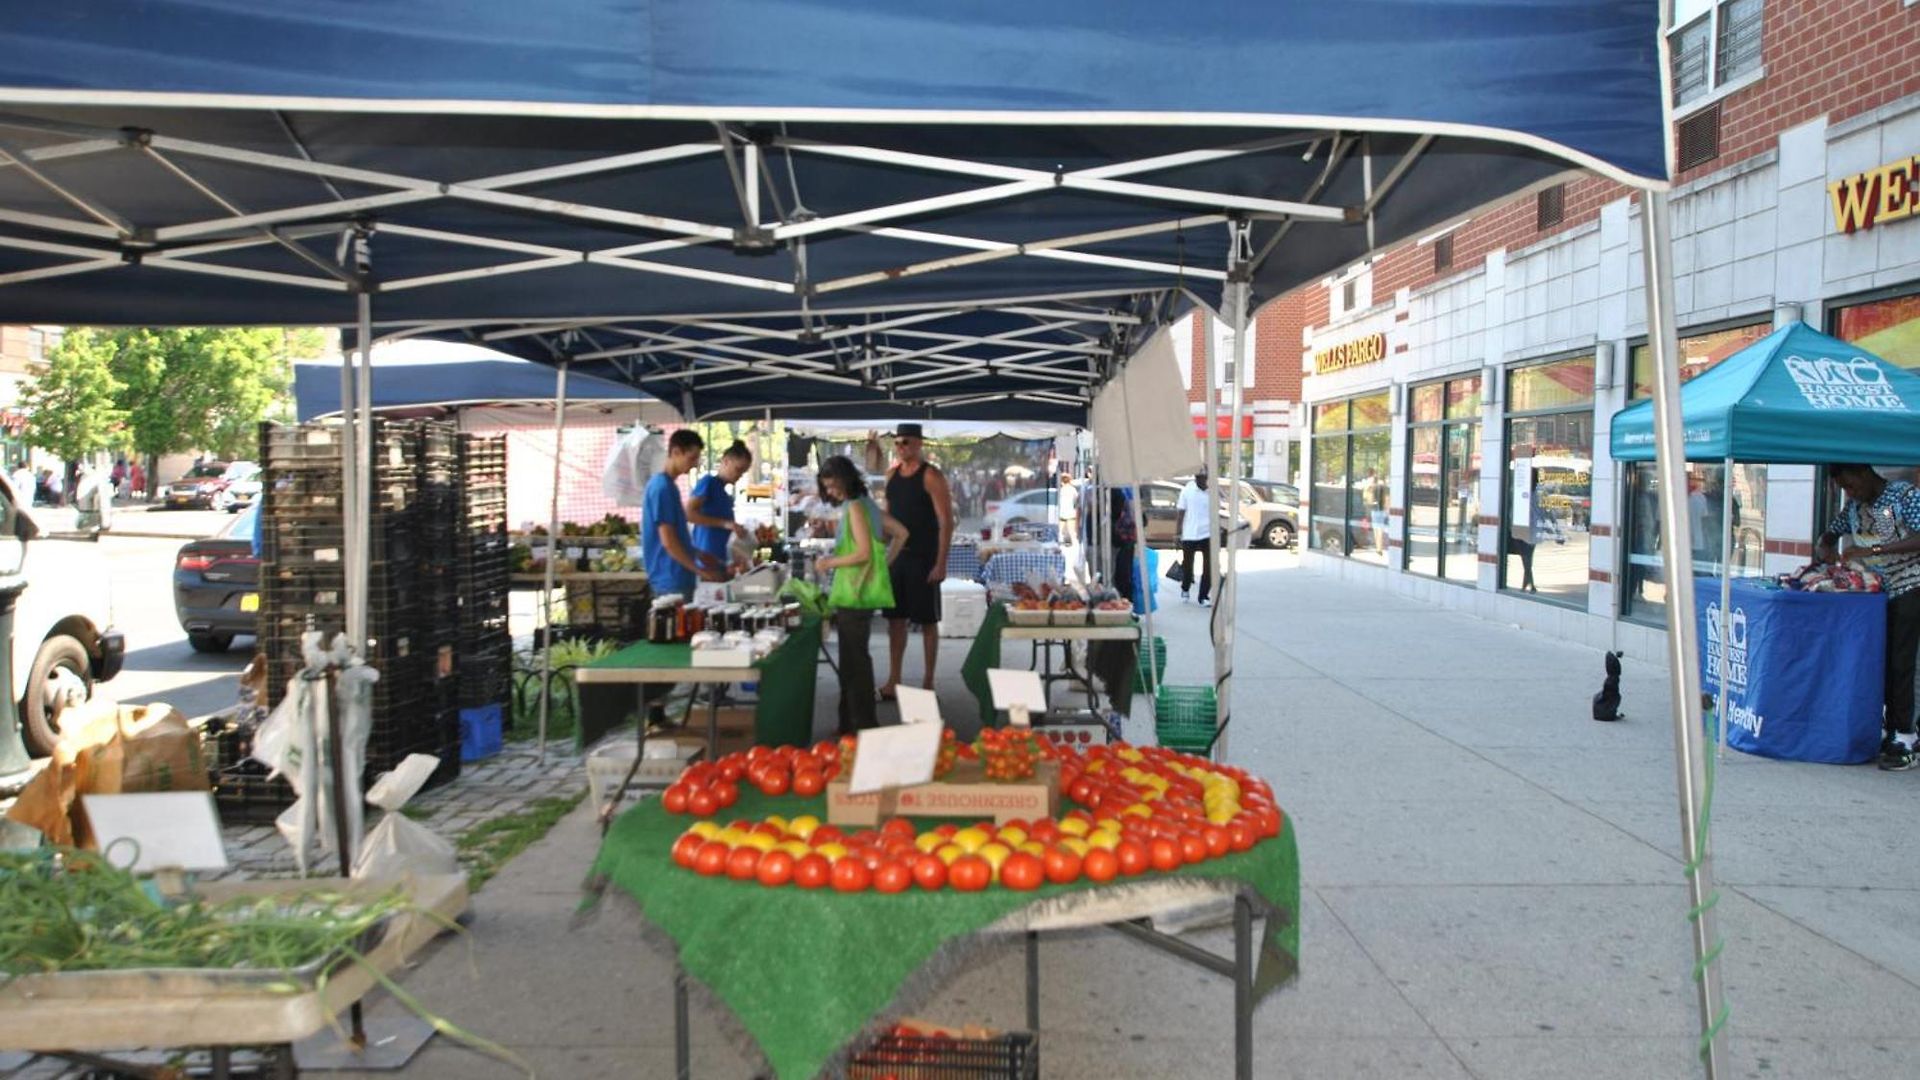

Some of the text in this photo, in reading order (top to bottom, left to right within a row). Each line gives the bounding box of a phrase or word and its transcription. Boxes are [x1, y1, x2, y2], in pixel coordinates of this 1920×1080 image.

[1827, 153, 1920, 233] WE
[1315, 332, 1385, 374] WELLS FARGO
[1799, 384, 1895, 396] HARVEST
[1805, 394, 1907, 409] HOME
[1706, 655, 1747, 686] HME
[928, 793, 1039, 809] GREENHOUSE
